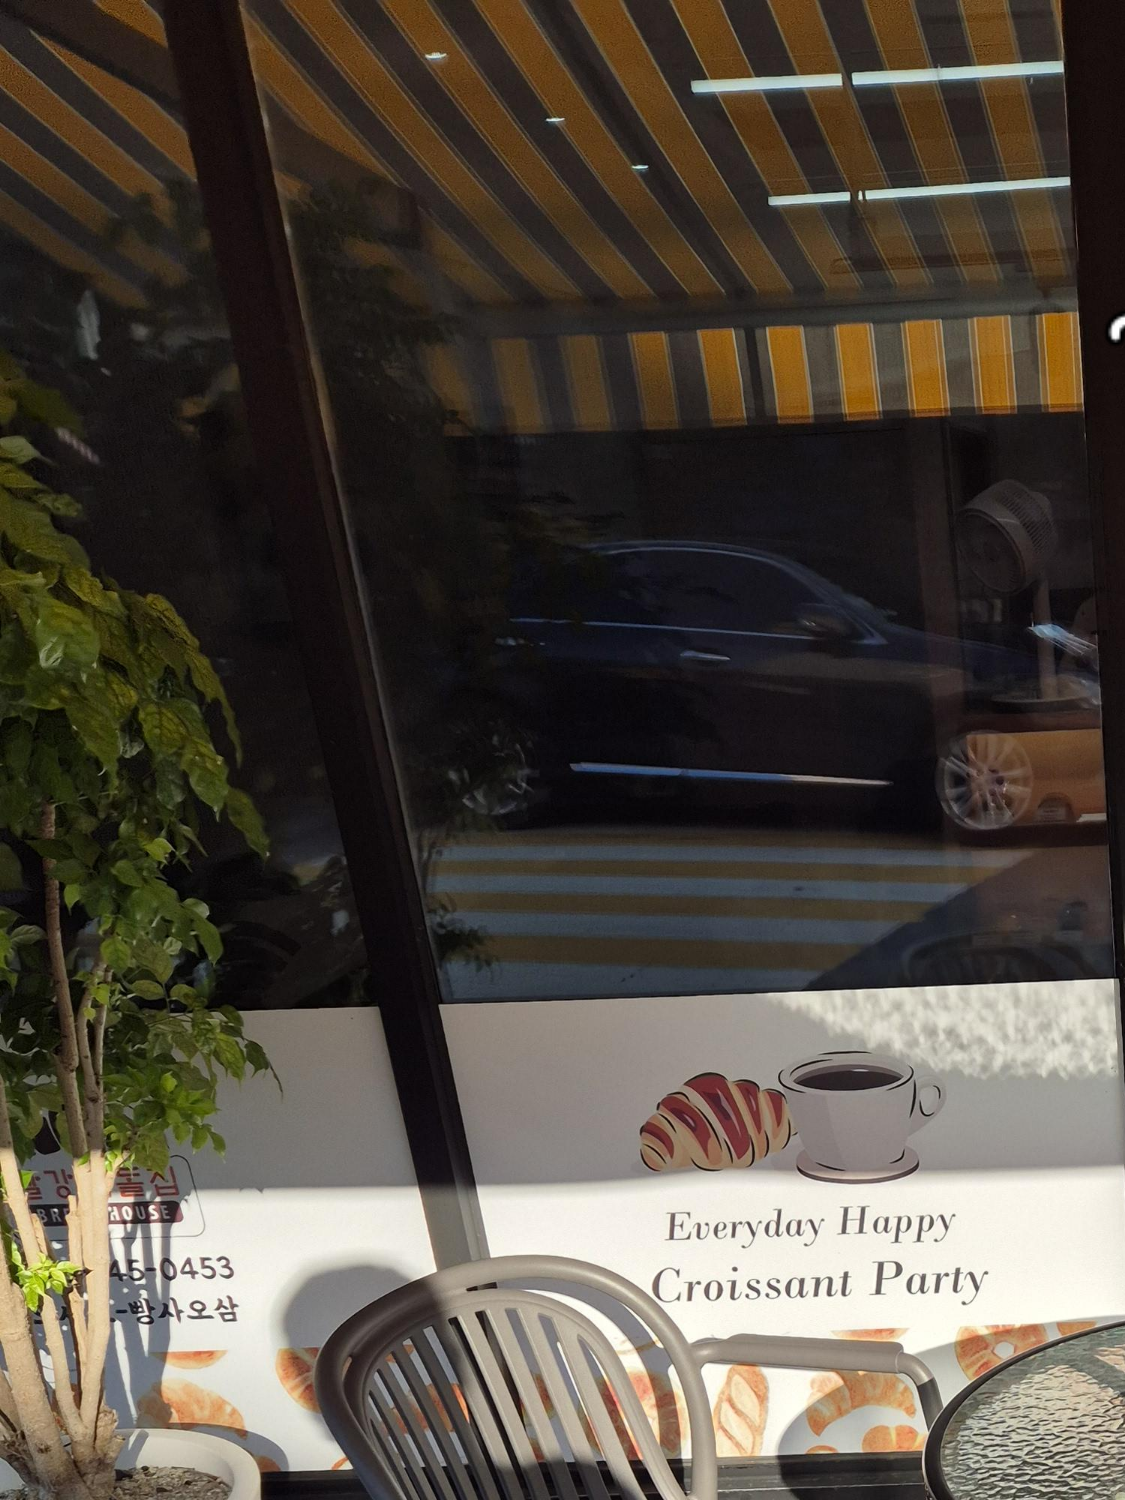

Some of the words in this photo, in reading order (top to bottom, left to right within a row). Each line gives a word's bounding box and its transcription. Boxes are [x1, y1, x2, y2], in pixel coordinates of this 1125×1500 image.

[664, 1209, 825, 1249] Everyday
[837, 1206, 956, 1244] Happy
[110, 1256, 235, 1281] 45-0453
[651, 1266, 853, 1303] Croissant
[869, 1260, 989, 1305] Party
